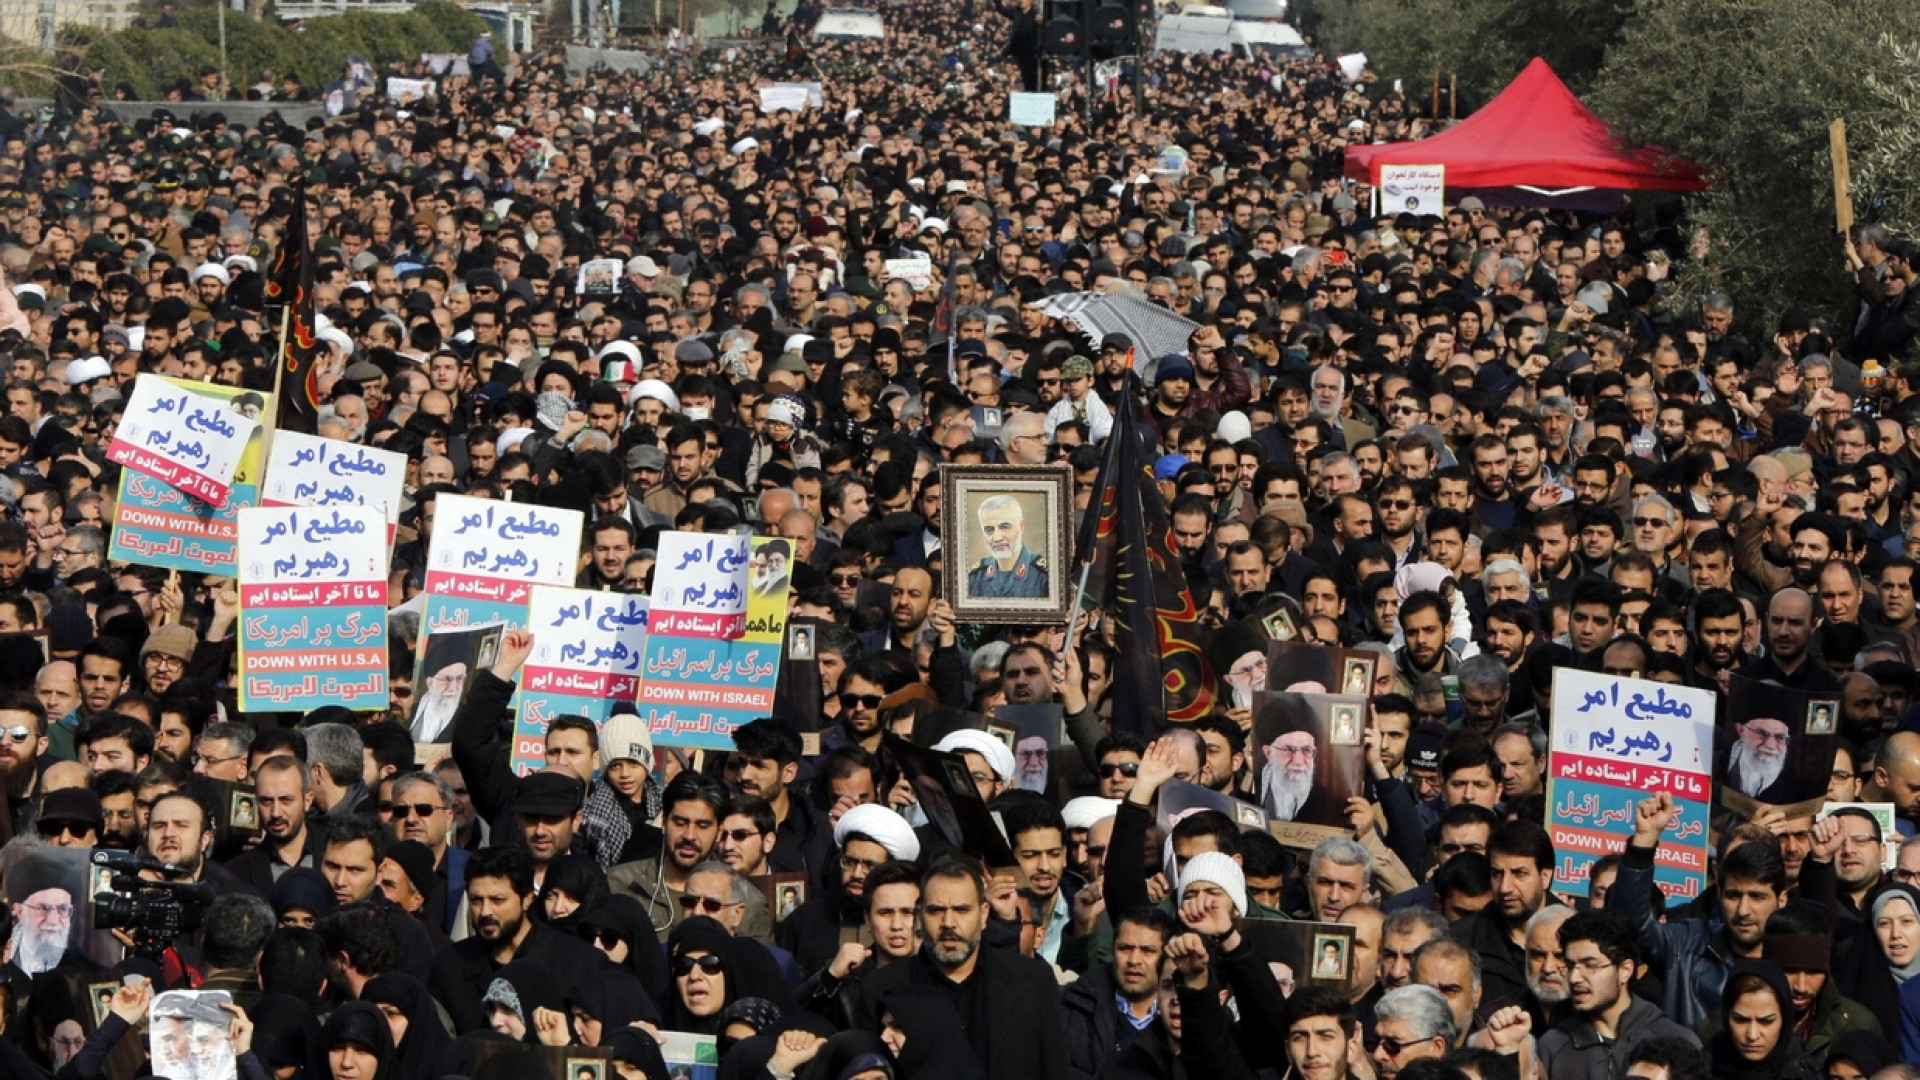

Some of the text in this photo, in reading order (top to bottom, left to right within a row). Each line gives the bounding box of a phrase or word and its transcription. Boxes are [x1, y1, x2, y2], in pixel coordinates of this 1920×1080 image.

[147, 395, 235, 439] مطیع امر
[146, 430, 210, 469] رهبریم
[288, 442, 386, 477] مطیع امر
[114, 449, 219, 499] ما تا آخر ایستاده ایم
[121, 510, 238, 537] DOWN WITH U.S.
[259, 510, 366, 545] مطیع امر
[453, 505, 560, 540] مطیع امر
[117, 528, 237, 566] لموت لامریکا
[462, 546, 539, 577] رهبریم
[675, 539, 749, 573] طیع امر
[273, 551, 350, 578] رهبریم
[249, 584, 380, 606] ما تا آخر ایستاده ایم
[434, 577, 530, 602] خر ایستاده ایم
[683, 582, 743, 609] رهبریم
[245, 611, 382, 647] مرگ بر امریکا
[550, 595, 648, 632] طیع امر
[655, 615, 674, 632] ایم
[677, 616, 721, 636] ایستاده
[769, 613, 782, 633] ما
[247, 653, 381, 669] DOWN WITH U.S.A
[560, 639, 639, 670] رهبریم
[647, 646, 773, 682] مرگ بر اسرائیل
[248, 673, 384, 703] الموت لامریکا
[531, 672, 639, 698] آخر ایستاده ایم
[643, 686, 768, 706] DOWN WITH ISRAEL
[1577, 681, 1692, 720] مطیع امر
[520, 741, 544, 754] DO
[1589, 727, 1672, 762] رهبریم
[1561, 759, 1702, 793] ما تا آخر ایستاده ایم
[1556, 790, 1632, 826] اسرائیل
[1556, 831, 1701, 867] DOWN WI SRAEL
[1653, 876, 1698, 899] المو
